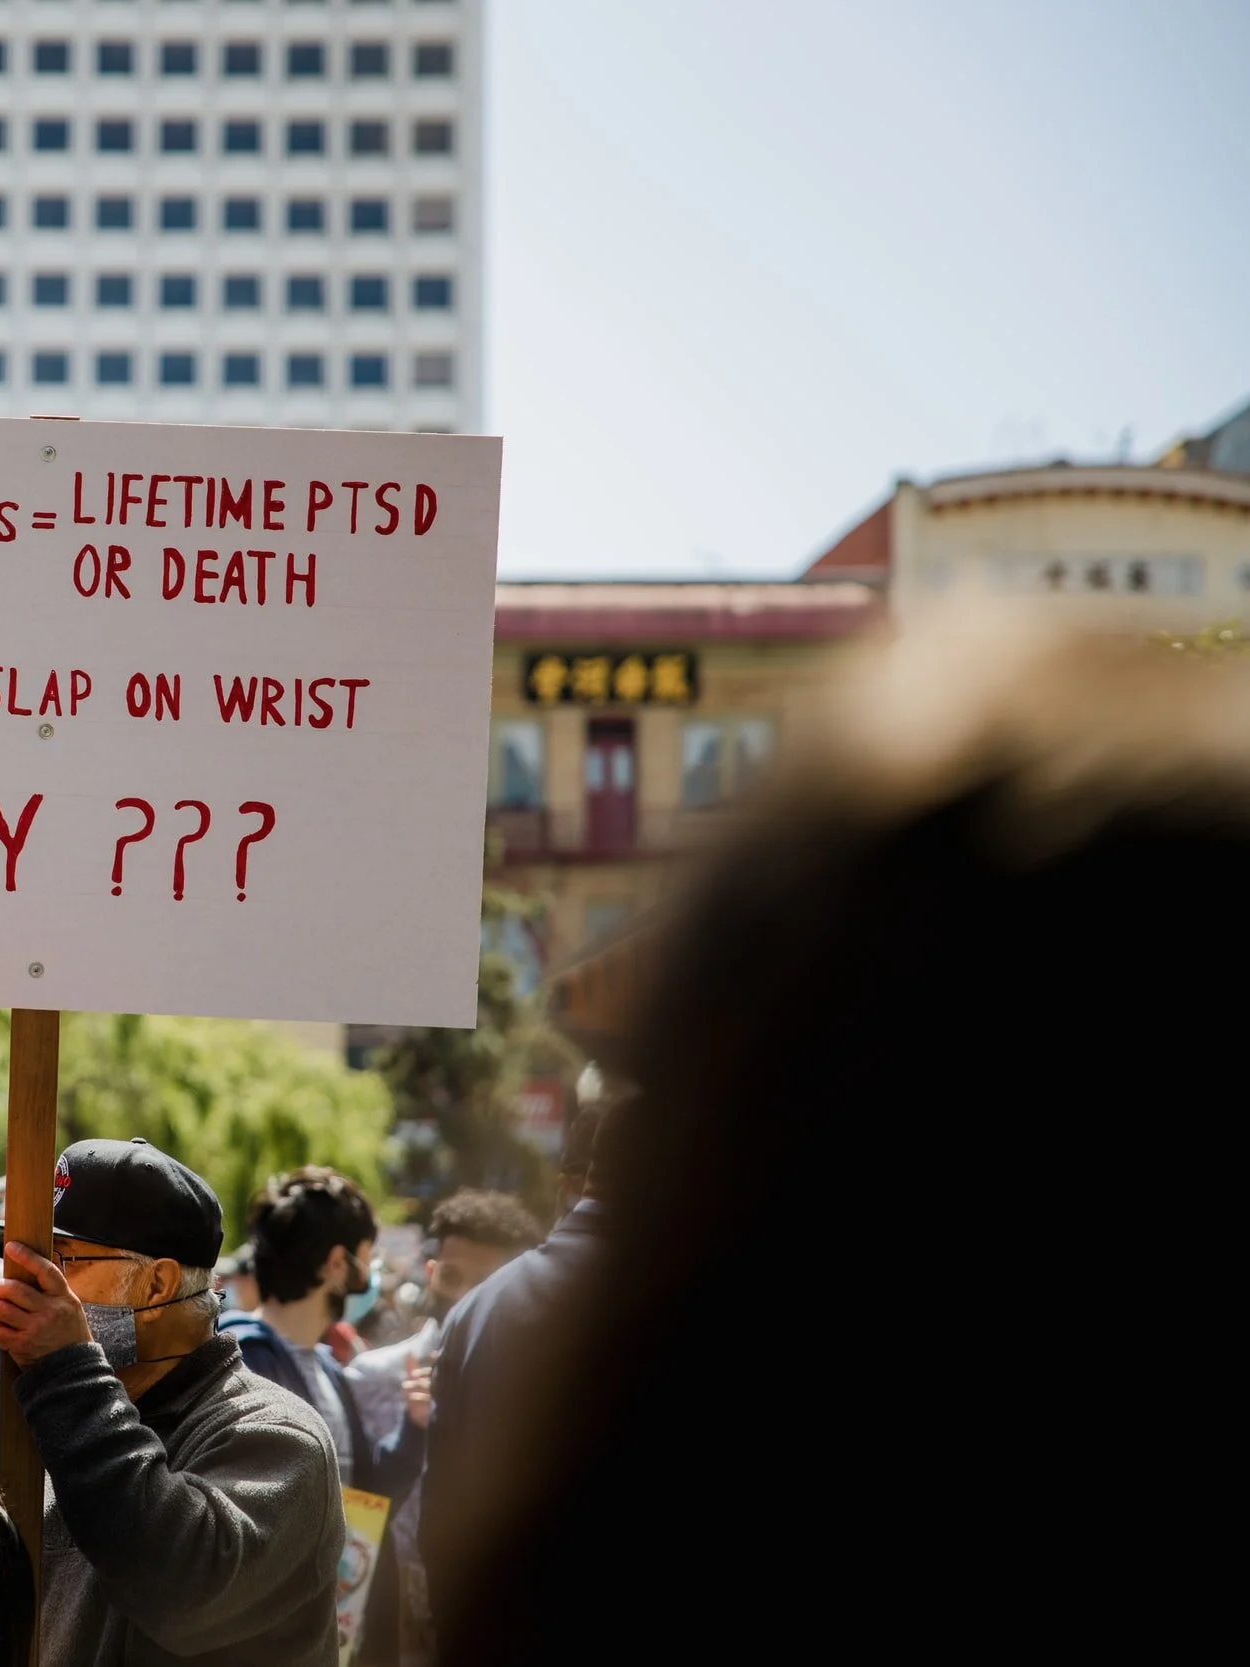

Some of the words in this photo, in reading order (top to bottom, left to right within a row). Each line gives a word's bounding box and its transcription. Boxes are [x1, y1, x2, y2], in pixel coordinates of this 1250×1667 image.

[72, 471, 286, 533] LIFETIME
[306, 479, 439, 537] PTSD
[72, 543, 133, 600] OR
[161, 547, 318, 608] DEATH
[125, 671, 183, 722] ON
[212, 673, 371, 730] WRIST
[110, 797, 278, 903] ???
